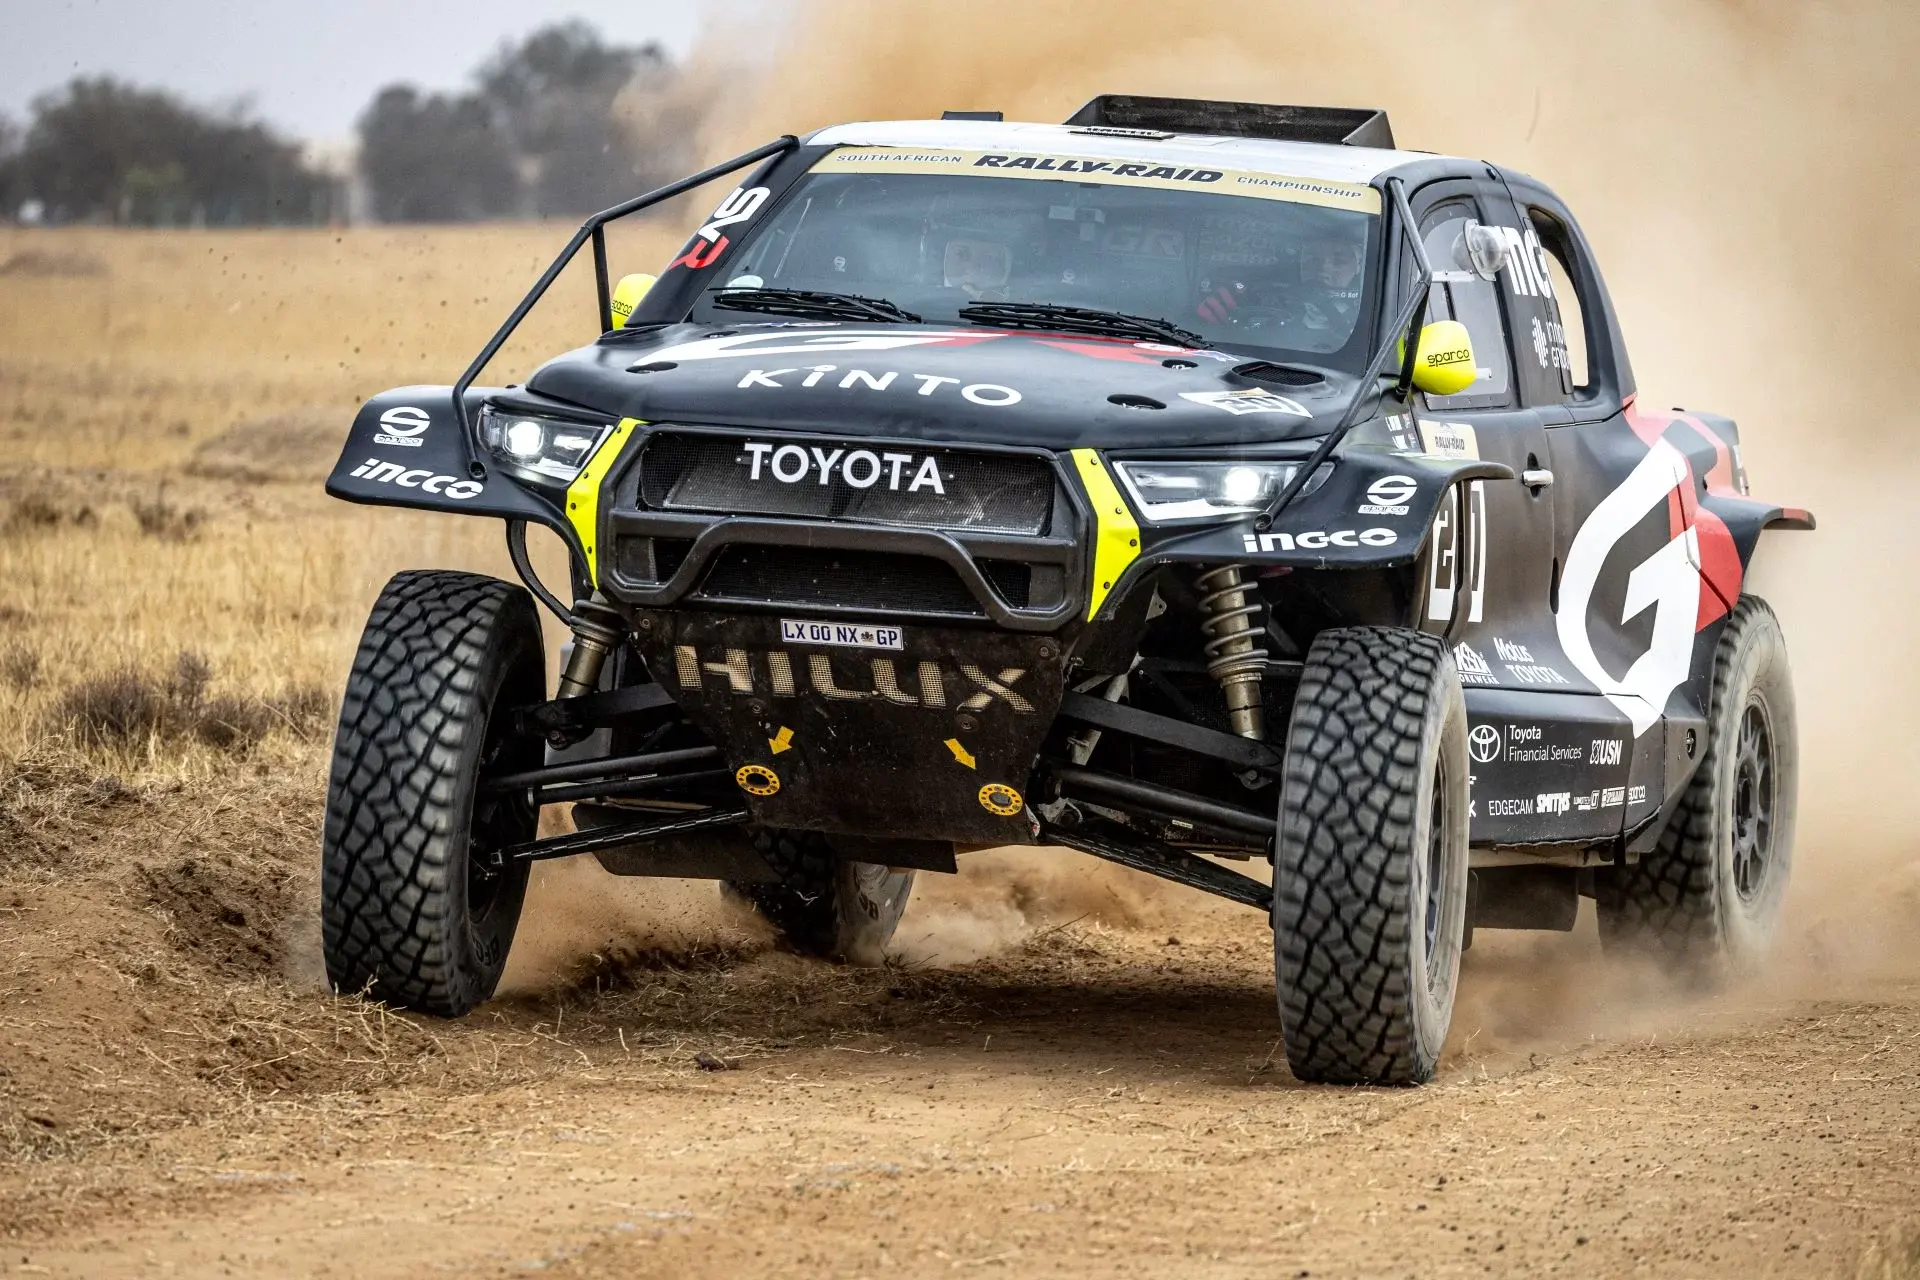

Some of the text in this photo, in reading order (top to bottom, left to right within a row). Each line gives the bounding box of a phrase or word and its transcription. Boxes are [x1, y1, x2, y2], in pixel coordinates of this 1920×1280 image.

[836, 154, 1362, 199] SOUTH AFRICAN RALLY-RAID CHAMPIONSHIP
[1427, 349, 1470, 367] sparco
[744, 443, 945, 495] TOYOTA
[1362, 505, 1407, 515] sparco
[783, 622, 806, 640] LX
[836, 626, 859, 644] NX
[876, 629, 899, 646] GP
[1493, 636, 1535, 664] Motus
[674, 645, 1037, 716] HILUX
[1459, 674, 1501, 685] ORKWEAR
[1505, 664, 1572, 684] TOYOTA
[1510, 725, 1542, 744] Toyota
[1509, 745, 1583, 762] Financial Services
[1600, 739, 1623, 766] USN
[1628, 785, 1647, 806] sparco
[1488, 799, 1534, 817] EDGECAM
